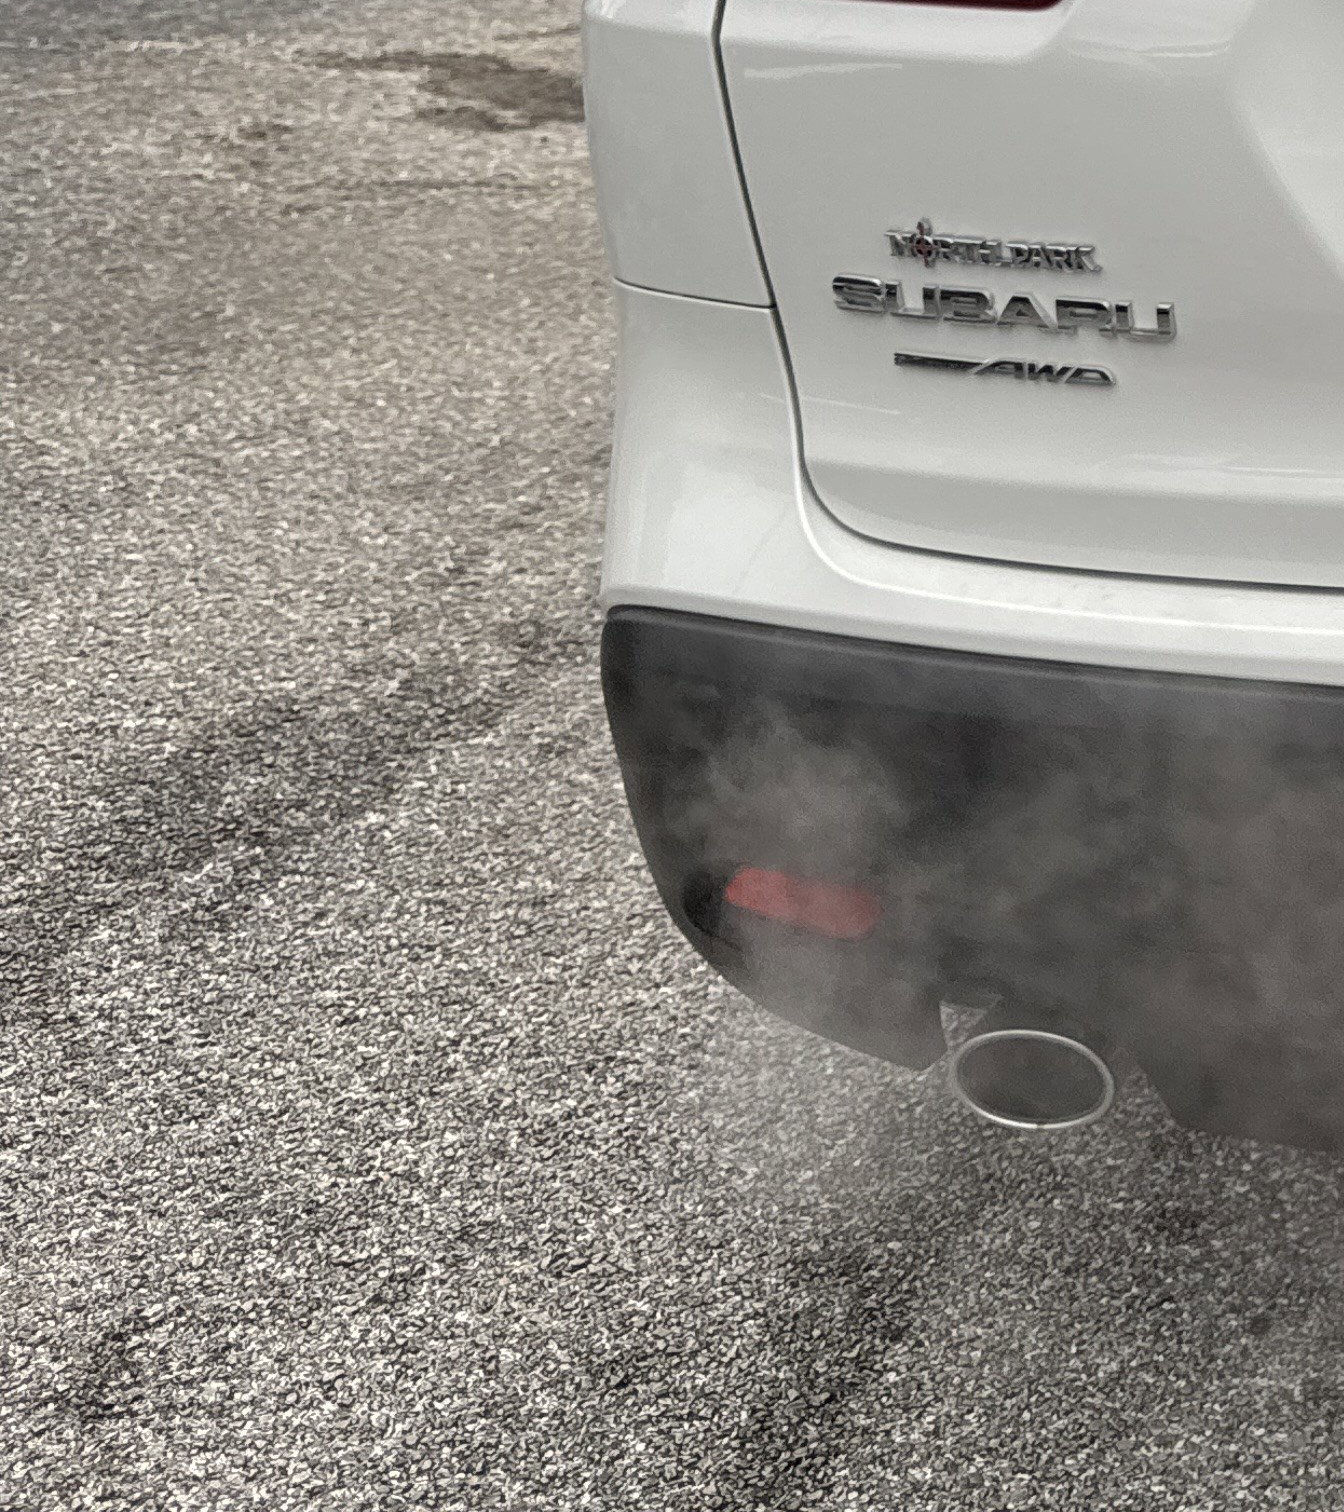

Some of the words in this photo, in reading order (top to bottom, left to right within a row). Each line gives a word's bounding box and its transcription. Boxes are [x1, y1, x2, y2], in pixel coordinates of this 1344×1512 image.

[1004, 240, 1103, 273] PARK
[832, 272, 1178, 340] SUBARU
[972, 357, 1117, 387] AWD
